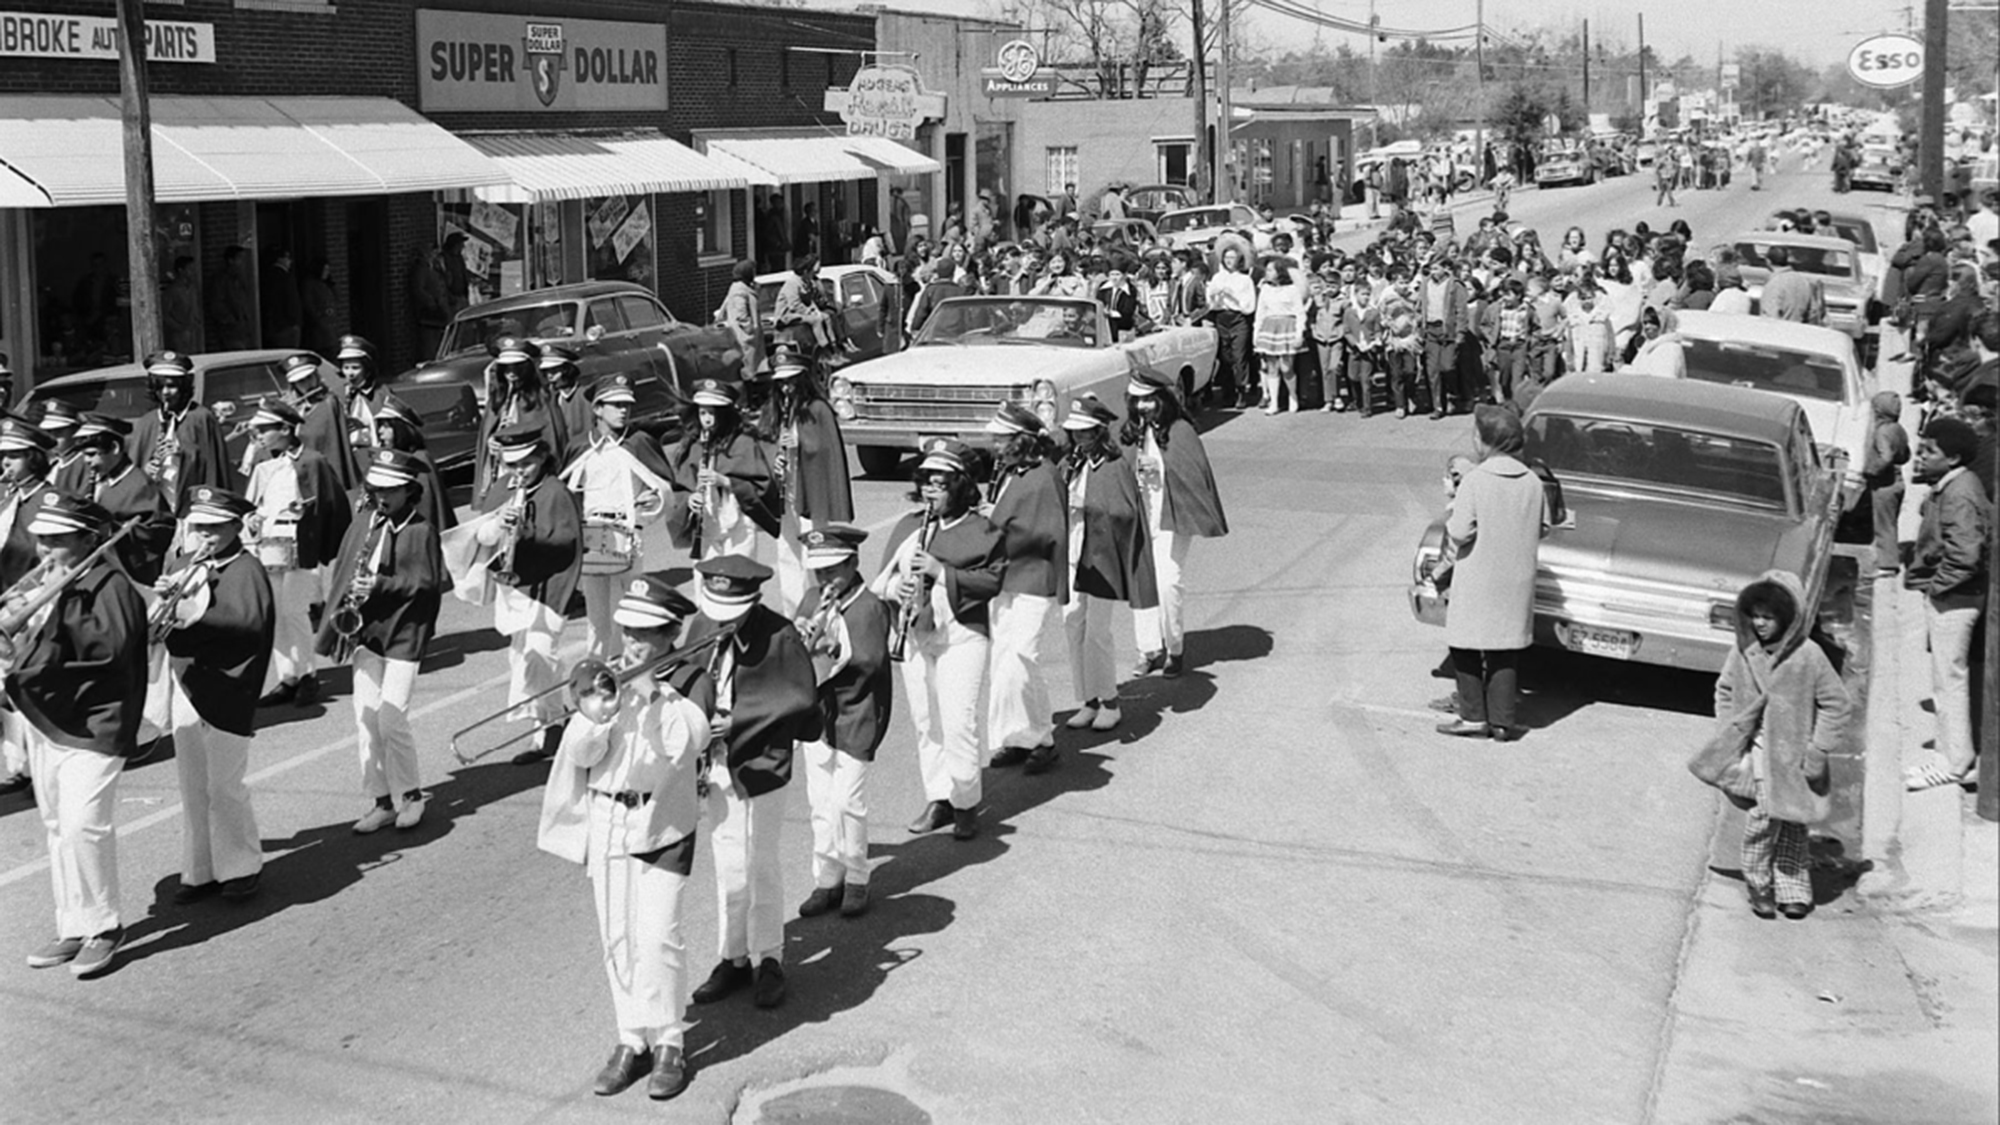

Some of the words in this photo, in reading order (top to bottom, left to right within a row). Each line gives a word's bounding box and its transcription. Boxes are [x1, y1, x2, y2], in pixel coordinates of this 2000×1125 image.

[0, 16, 80, 53] BROKE
[91, 26, 119, 51] AUT
[528, 38, 561, 51] DOLLAR
[536, 26, 559, 38] SUPER
[430, 41, 515, 82] SUPER
[574, 46, 658, 84] DOLLAR
